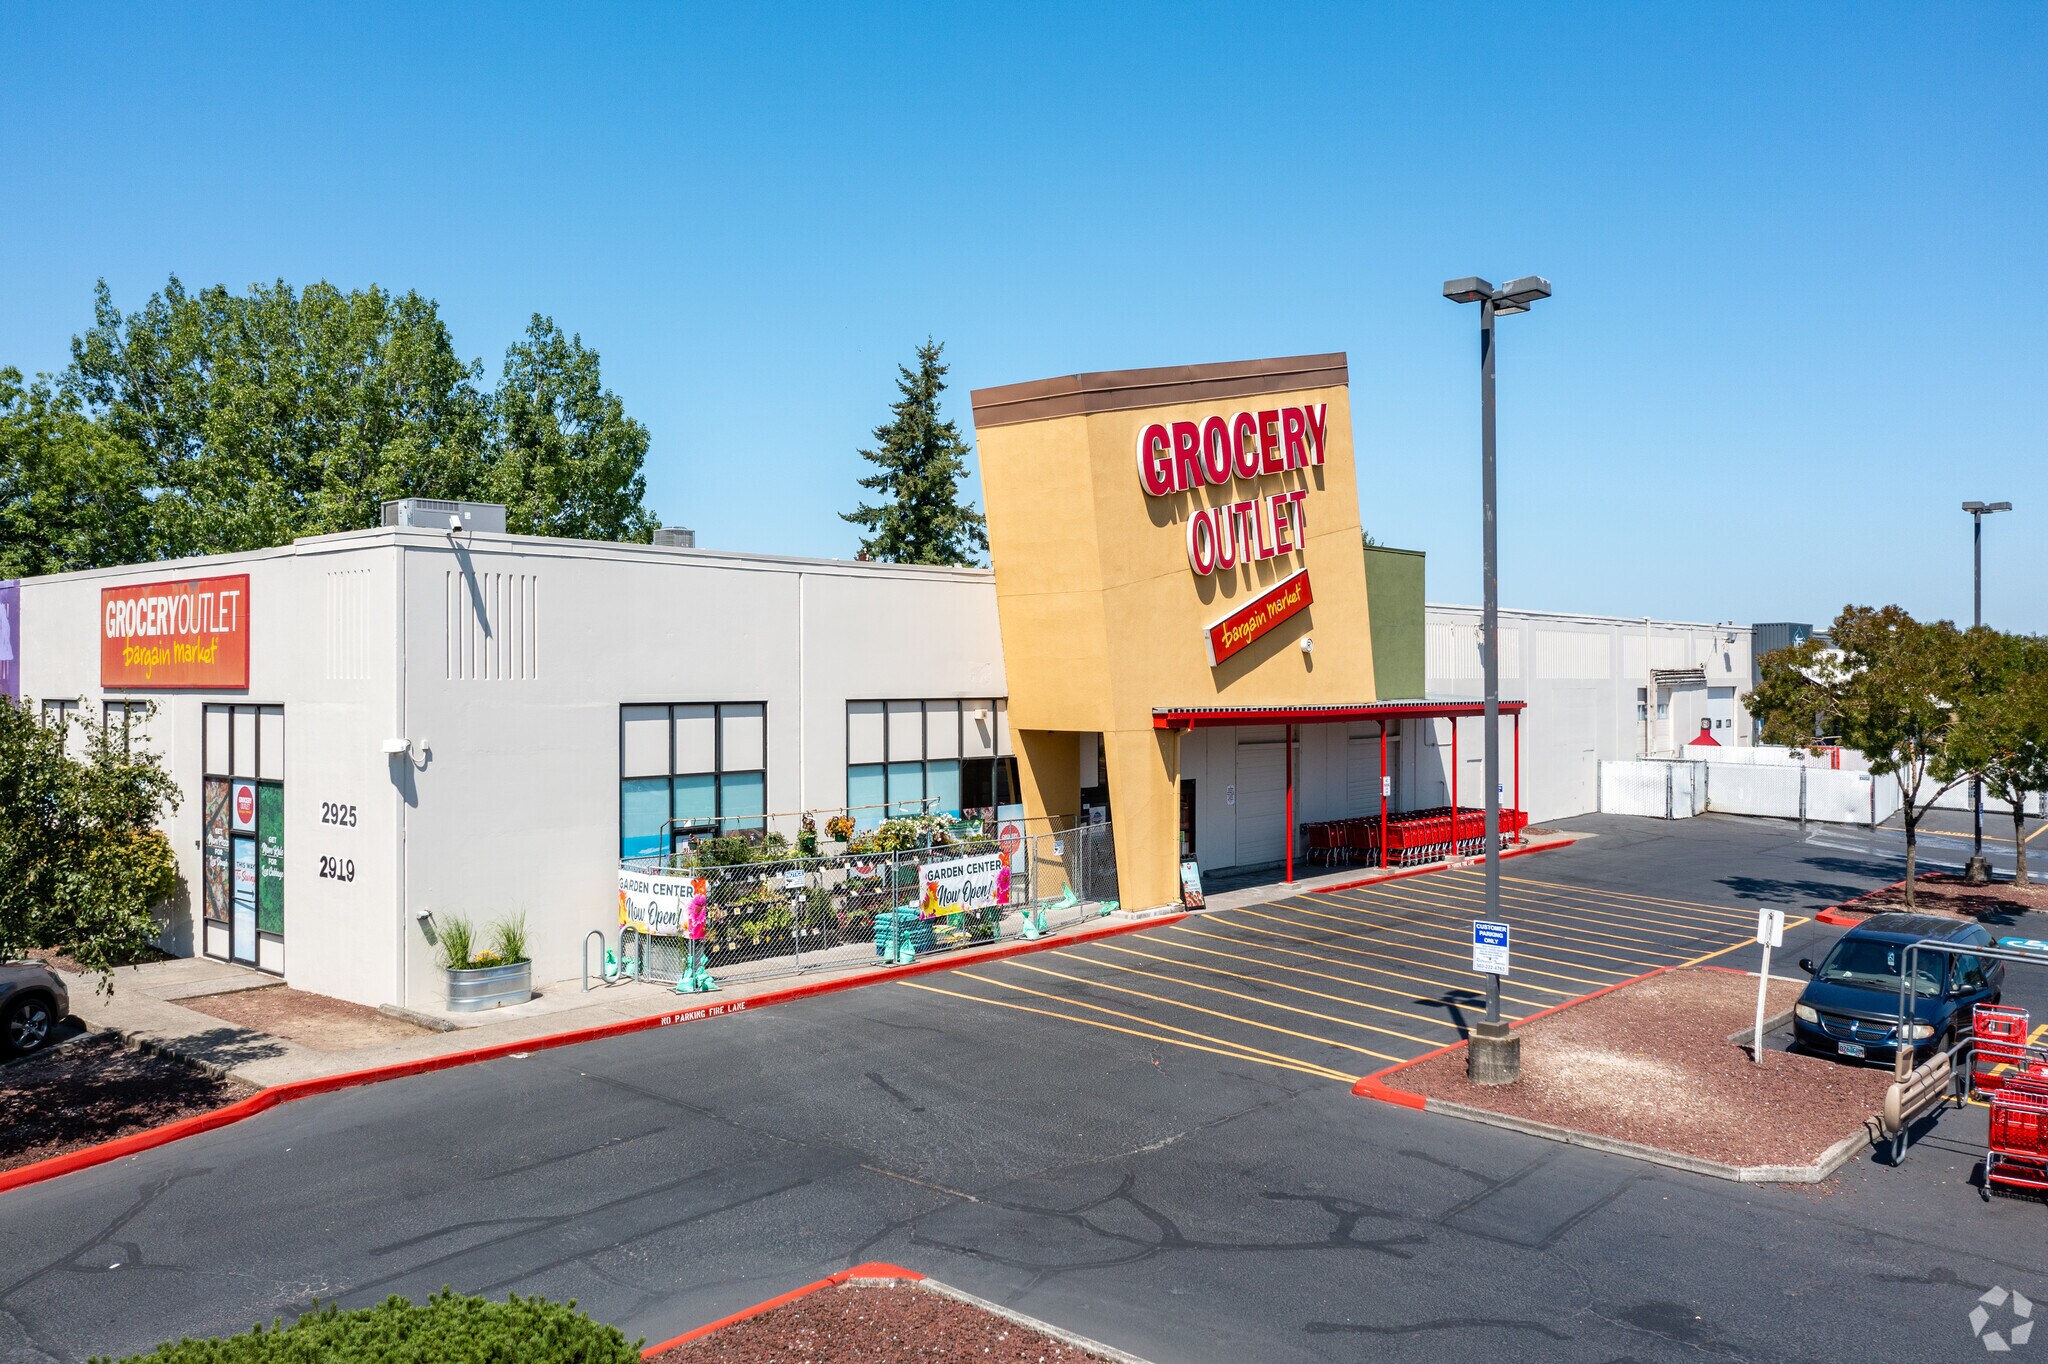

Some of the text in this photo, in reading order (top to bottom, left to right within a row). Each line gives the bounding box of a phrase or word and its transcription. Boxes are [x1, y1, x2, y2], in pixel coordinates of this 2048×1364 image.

[1137, 403, 1327, 496] GROCERY
[1187, 490, 1306, 576] OUTLET
[1222, 583, 1301, 648] bargain market
[123, 634, 218, 679] bargain market
[322, 802, 356, 827] 2925
[320, 856, 355, 882] 2919
[928, 860, 1001, 881] GARDEN CENTER
[619, 877, 694, 898] GARDEN CENTER
[937, 880, 993, 907] Now Open!
[626, 897, 682, 931] Now Open!
[1476, 924, 1507, 932] CUSTOMER
[1479, 930, 1503, 938] PARKING
[661, 1002, 746, 1025] NO PARKING FIRE LANE
